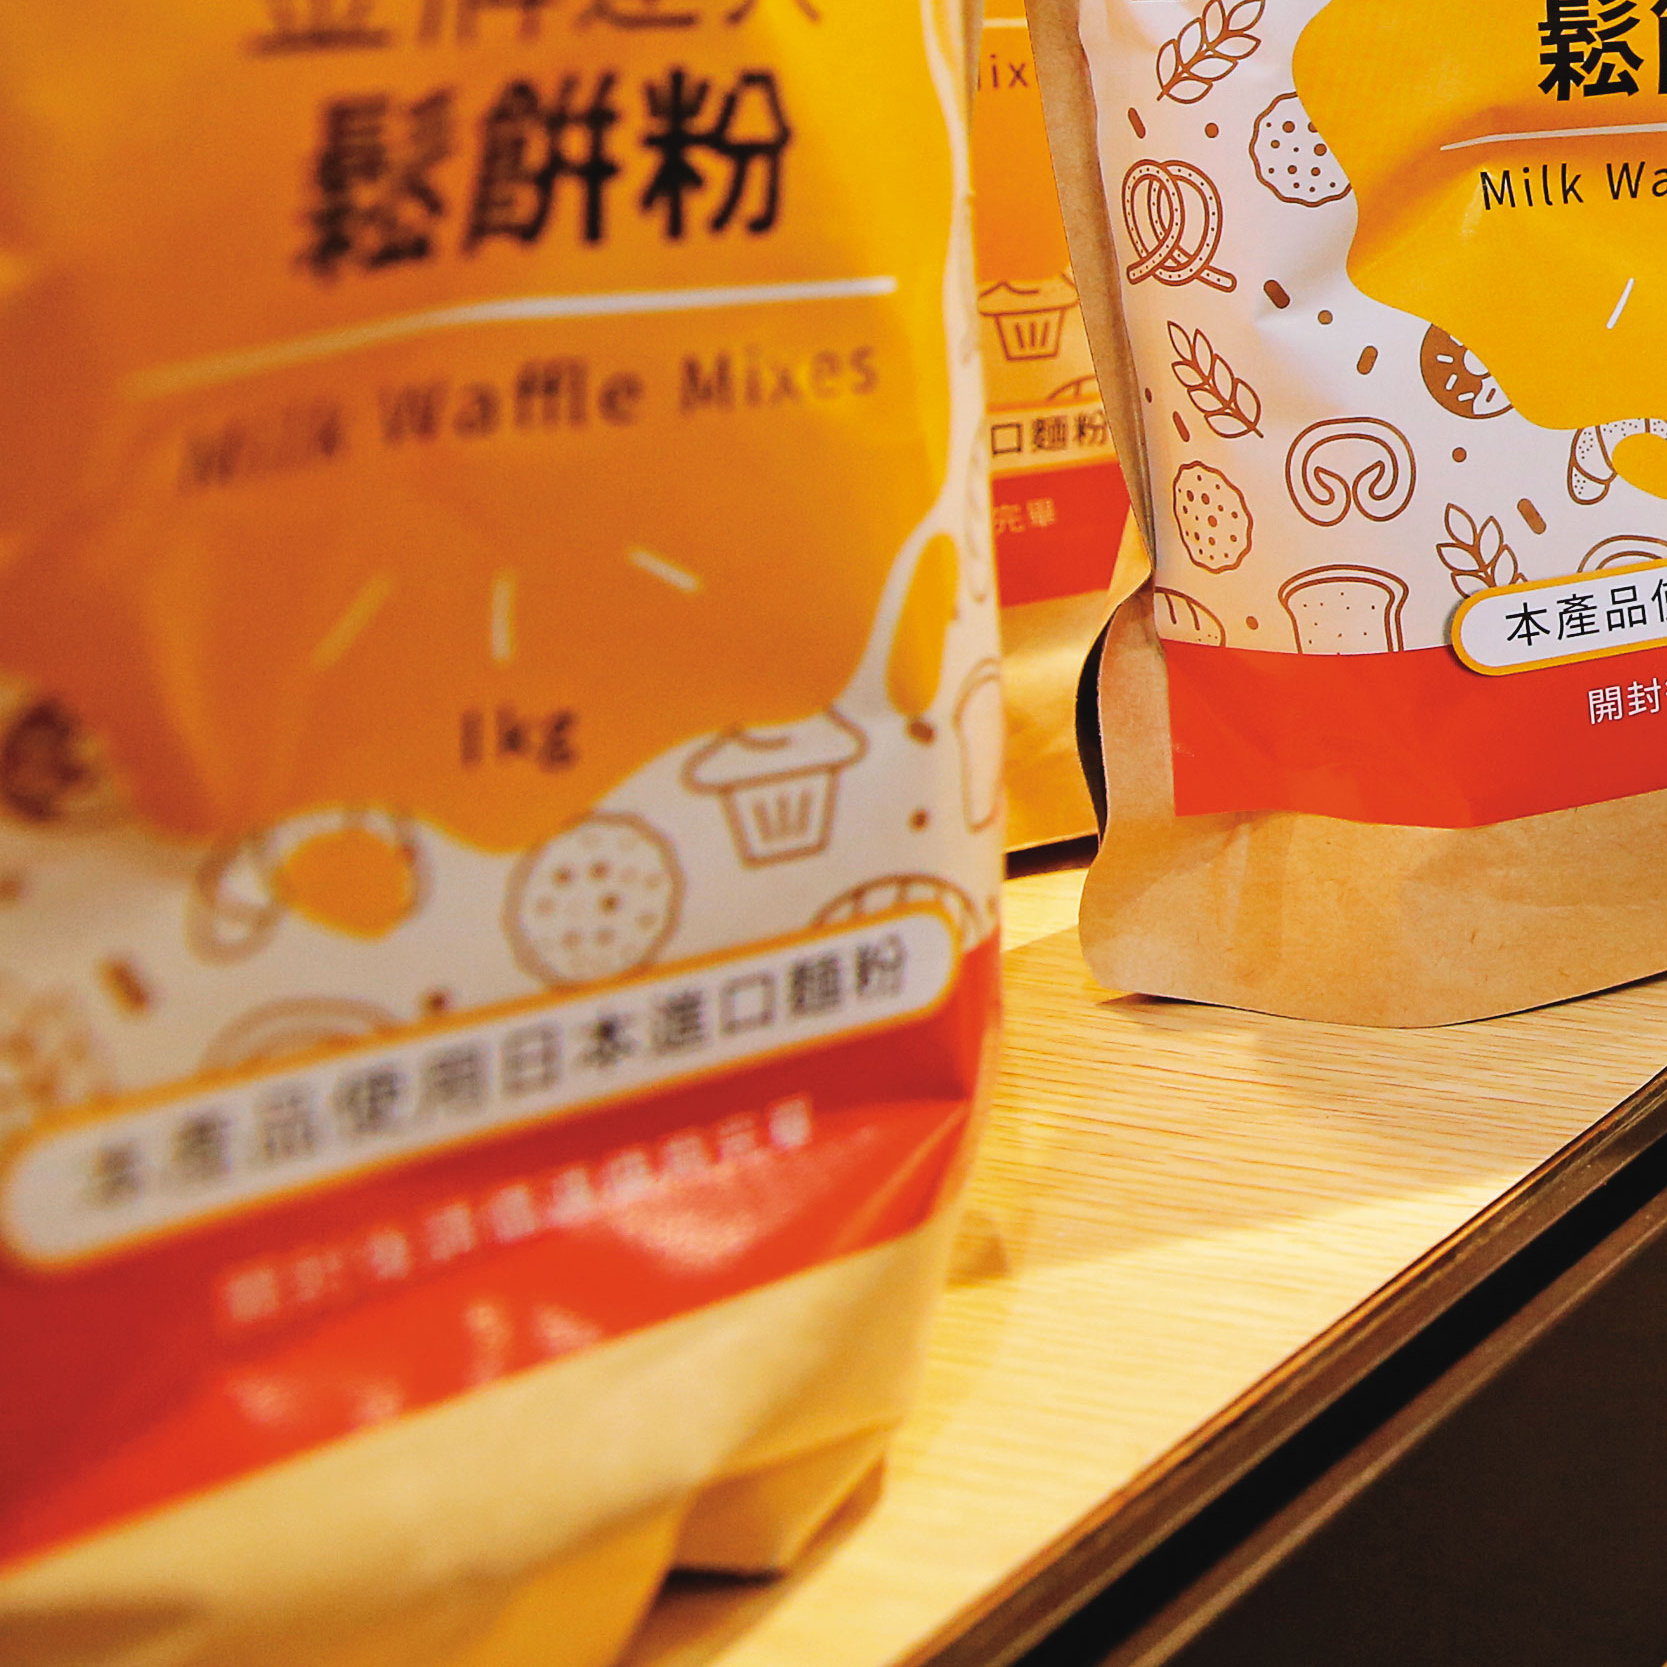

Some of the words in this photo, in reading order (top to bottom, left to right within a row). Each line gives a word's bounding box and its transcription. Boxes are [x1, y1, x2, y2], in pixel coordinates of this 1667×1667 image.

[1479, 162, 1584, 211] Milk
[378, 354, 645, 442] Waffle
[679, 343, 880, 416] Mixes
